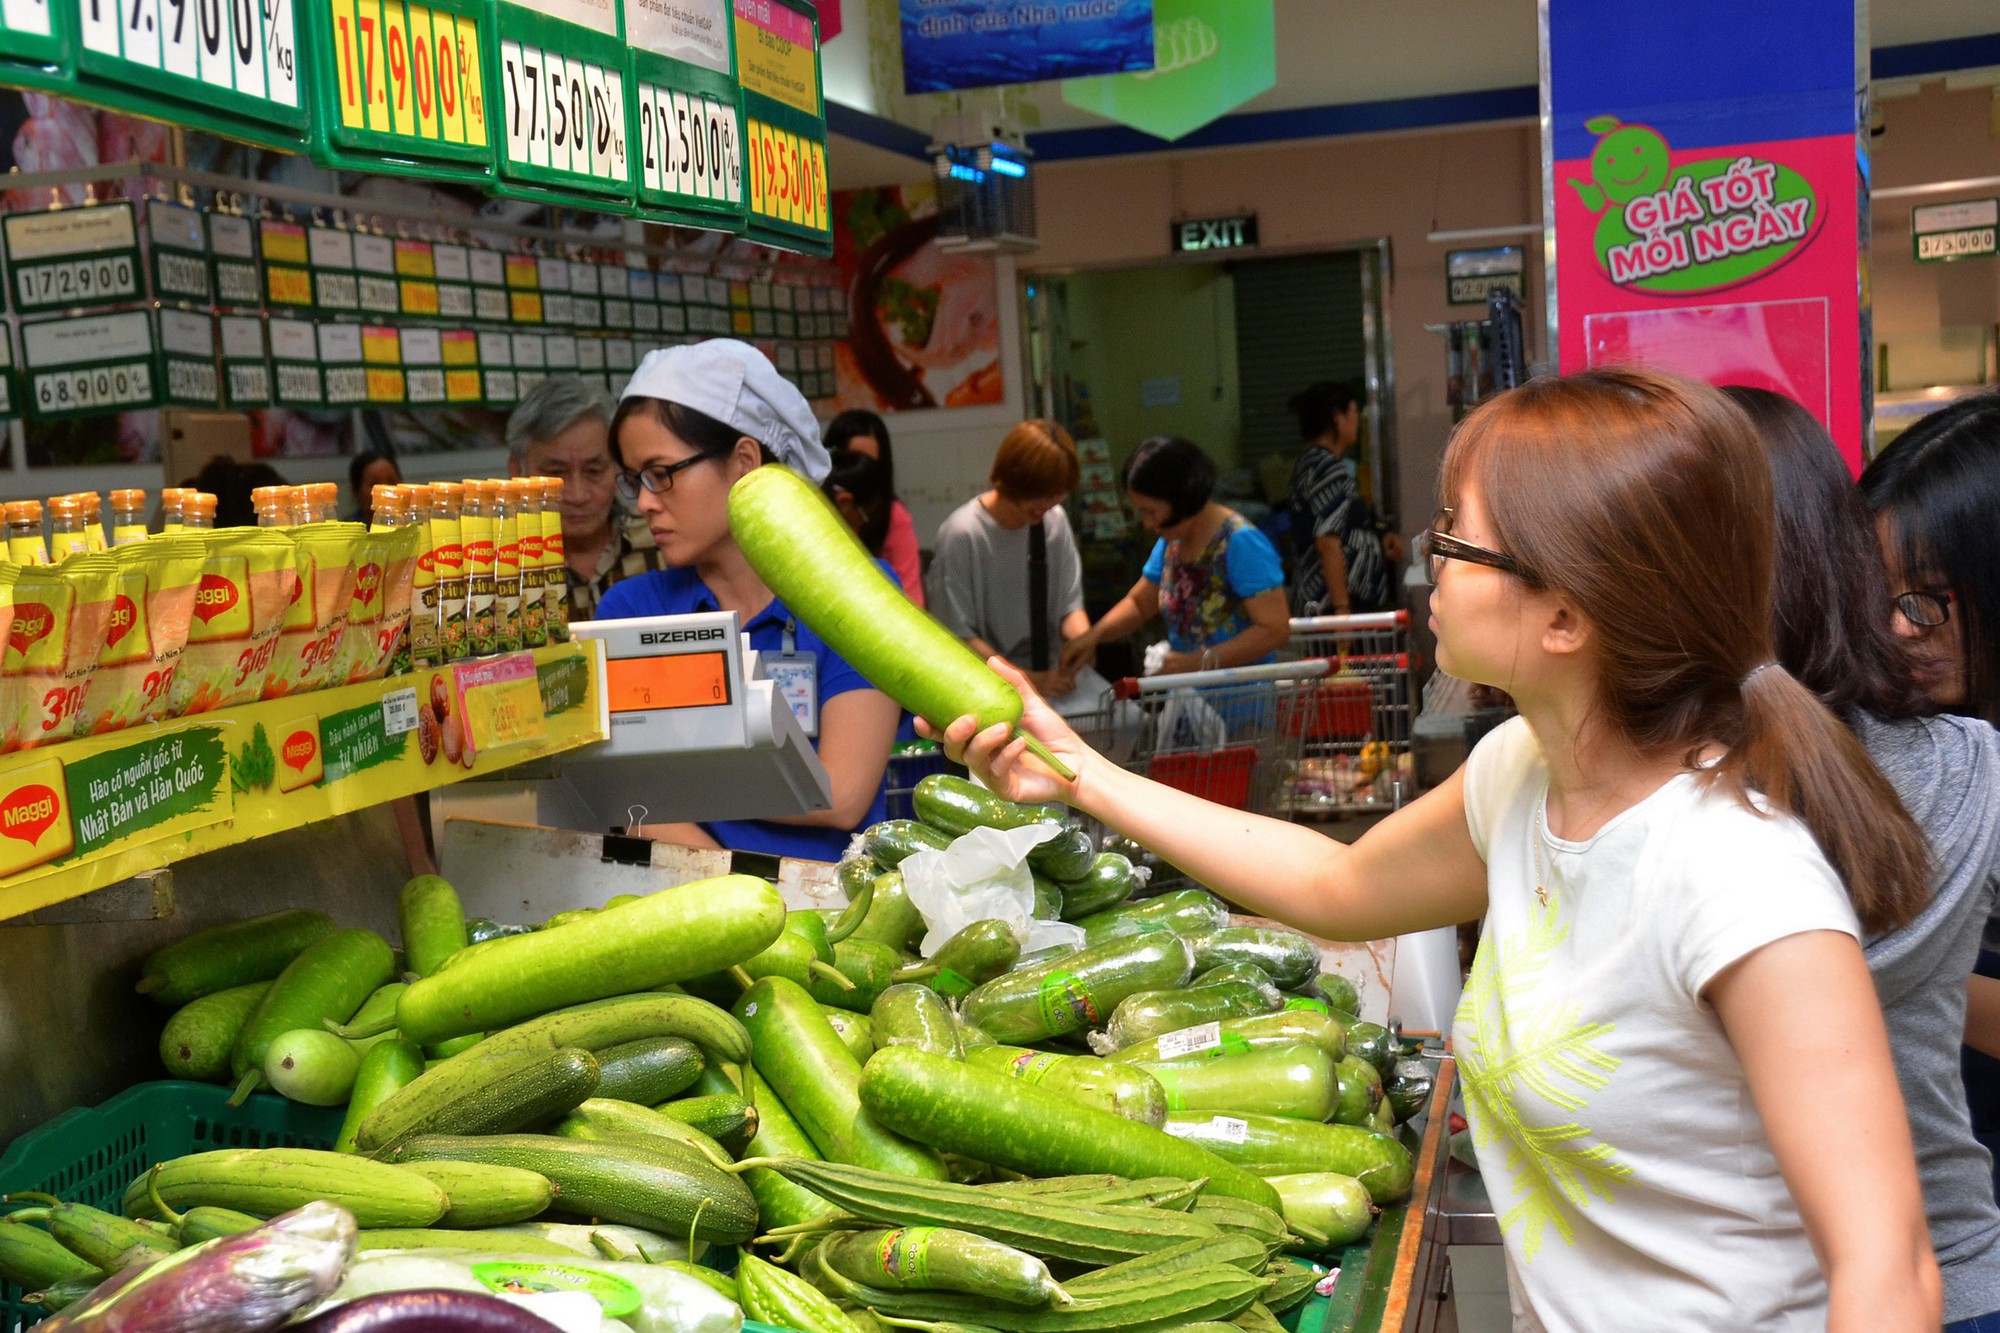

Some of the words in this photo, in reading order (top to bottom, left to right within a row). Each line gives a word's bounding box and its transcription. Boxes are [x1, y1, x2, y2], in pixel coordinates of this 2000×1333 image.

[918, 15, 966, 38] định
[971, 9, 1009, 31] của
[1015, 4, 1057, 25] Nhà
[339, 16, 455, 119] 17.900
[506, 60, 611, 155] 17.500
[642, 101, 720, 181] 21.500
[752, 138, 812, 214] 19.500
[1627, 178, 1701, 230] GIÁ
[1703, 159, 1776, 212] TỐT
[1181, 220, 1246, 250] EXIT
[1610, 228, 1687, 280] MỖI
[1692, 201, 1808, 257] NGÀY
[195, 586, 231, 605] aggi
[640, 628, 725, 645] BIZERBA
[643, 692, 651, 704] 0
[712, 685, 721, 699] 0
[286, 741, 313, 758] Maggi
[352, 731, 379, 763] nhiên
[123, 752, 152, 788] nguồn
[153, 743, 171, 778] gốc
[4, 795, 54, 828] Maggi
[79, 813, 110, 844] Nhật
[112, 794, 133, 827] Bản
[134, 785, 149, 814] và
[150, 777, 173, 806] Hàn
[174, 754, 205, 792] Quốc
